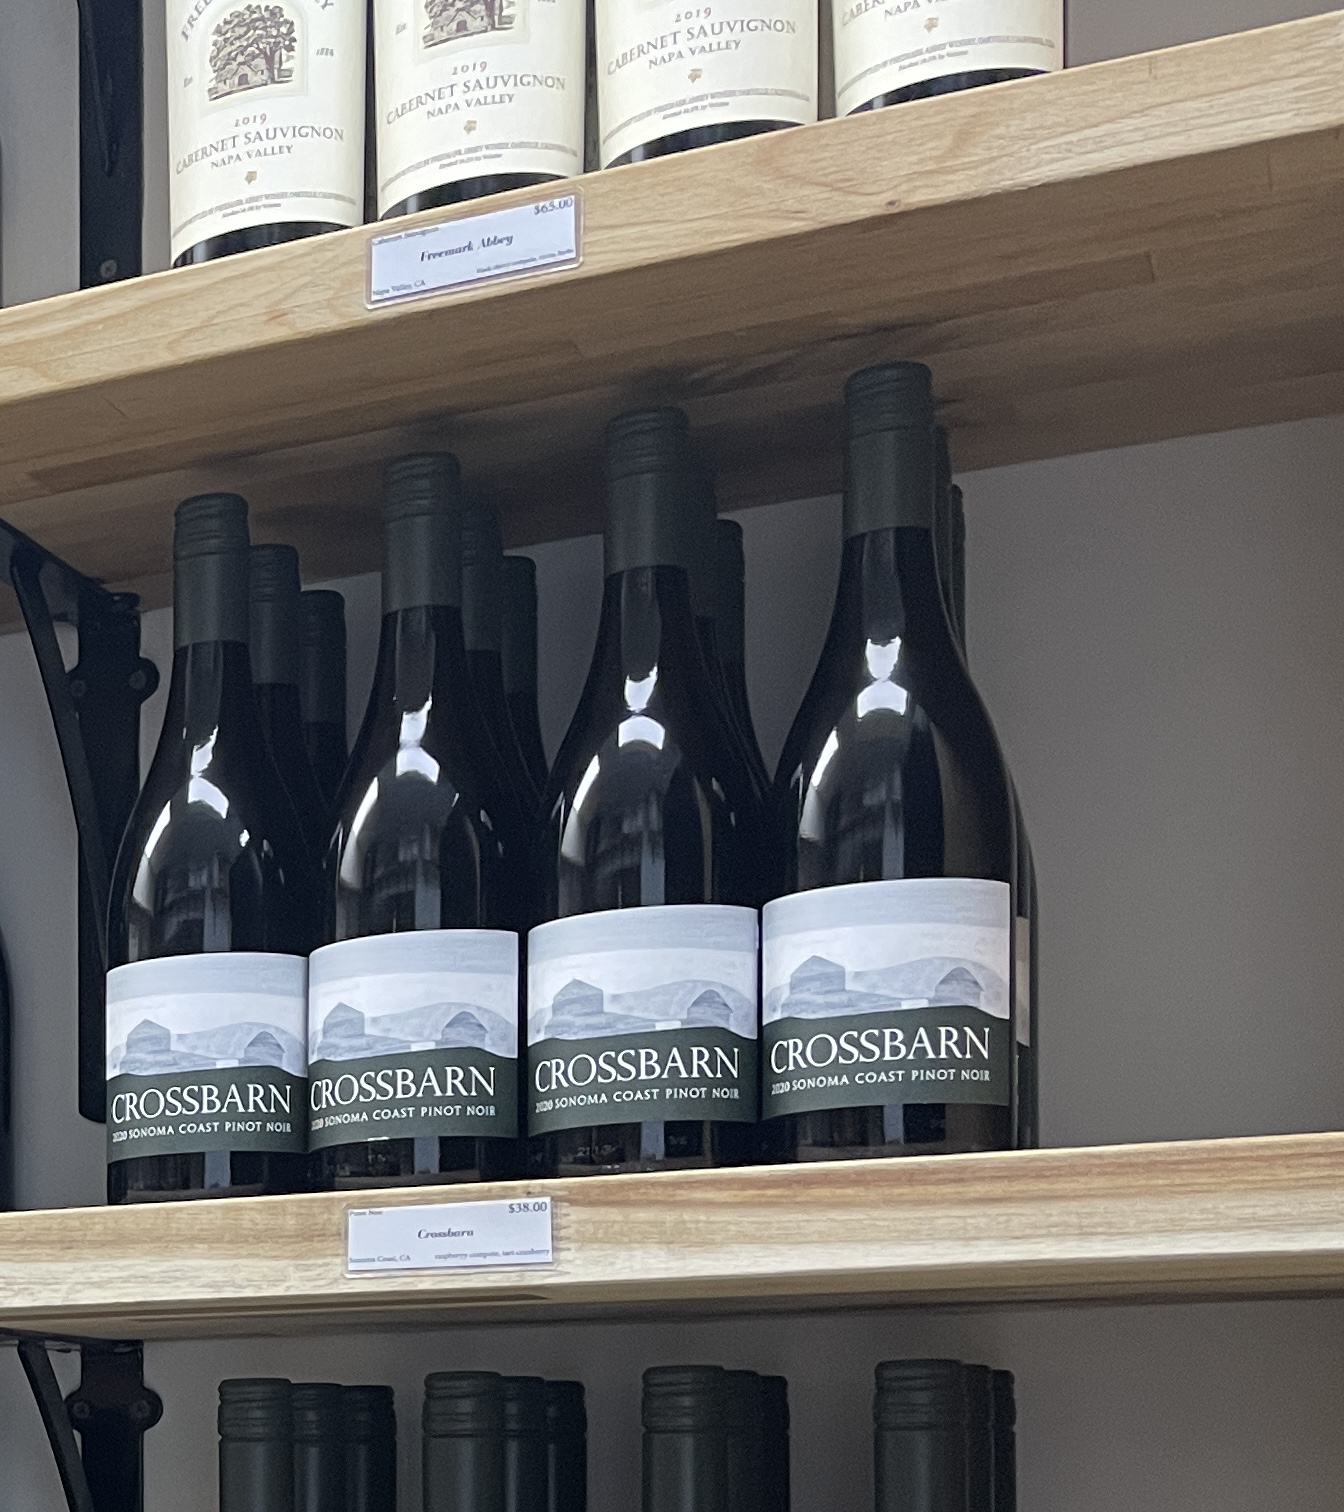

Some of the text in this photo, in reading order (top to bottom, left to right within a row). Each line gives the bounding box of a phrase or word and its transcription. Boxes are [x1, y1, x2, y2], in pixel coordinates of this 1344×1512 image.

[674, 7, 712, 22] 2019
[607, 19, 796, 75] CABERNET SAUVIGNON
[648, 39, 741, 69] NAPA VALLEY
[452, 61, 488, 75] 2019
[386, 74, 566, 124] CABERNET SAUVIGNON
[427, 94, 514, 120] NAPA VALLEY
[234, 113, 267, 126] 2019
[175, 124, 344, 174] CABERNET SAUVIGNON
[211, 145, 293, 169] NAPA VALLEY
[420, 240, 473, 262] Freemark
[477, 233, 513, 251] Abbey
[771, 1028, 990, 1073] CROSSBARN
[535, 1047, 739, 1092] CROSSBARN
[311, 1066, 495, 1110] CROSSBARN
[113, 1085, 291, 1123] CROSSBARN
[508, 1202, 547, 1214] $38.00
[418, 1228, 474, 1240] Crossbarn
